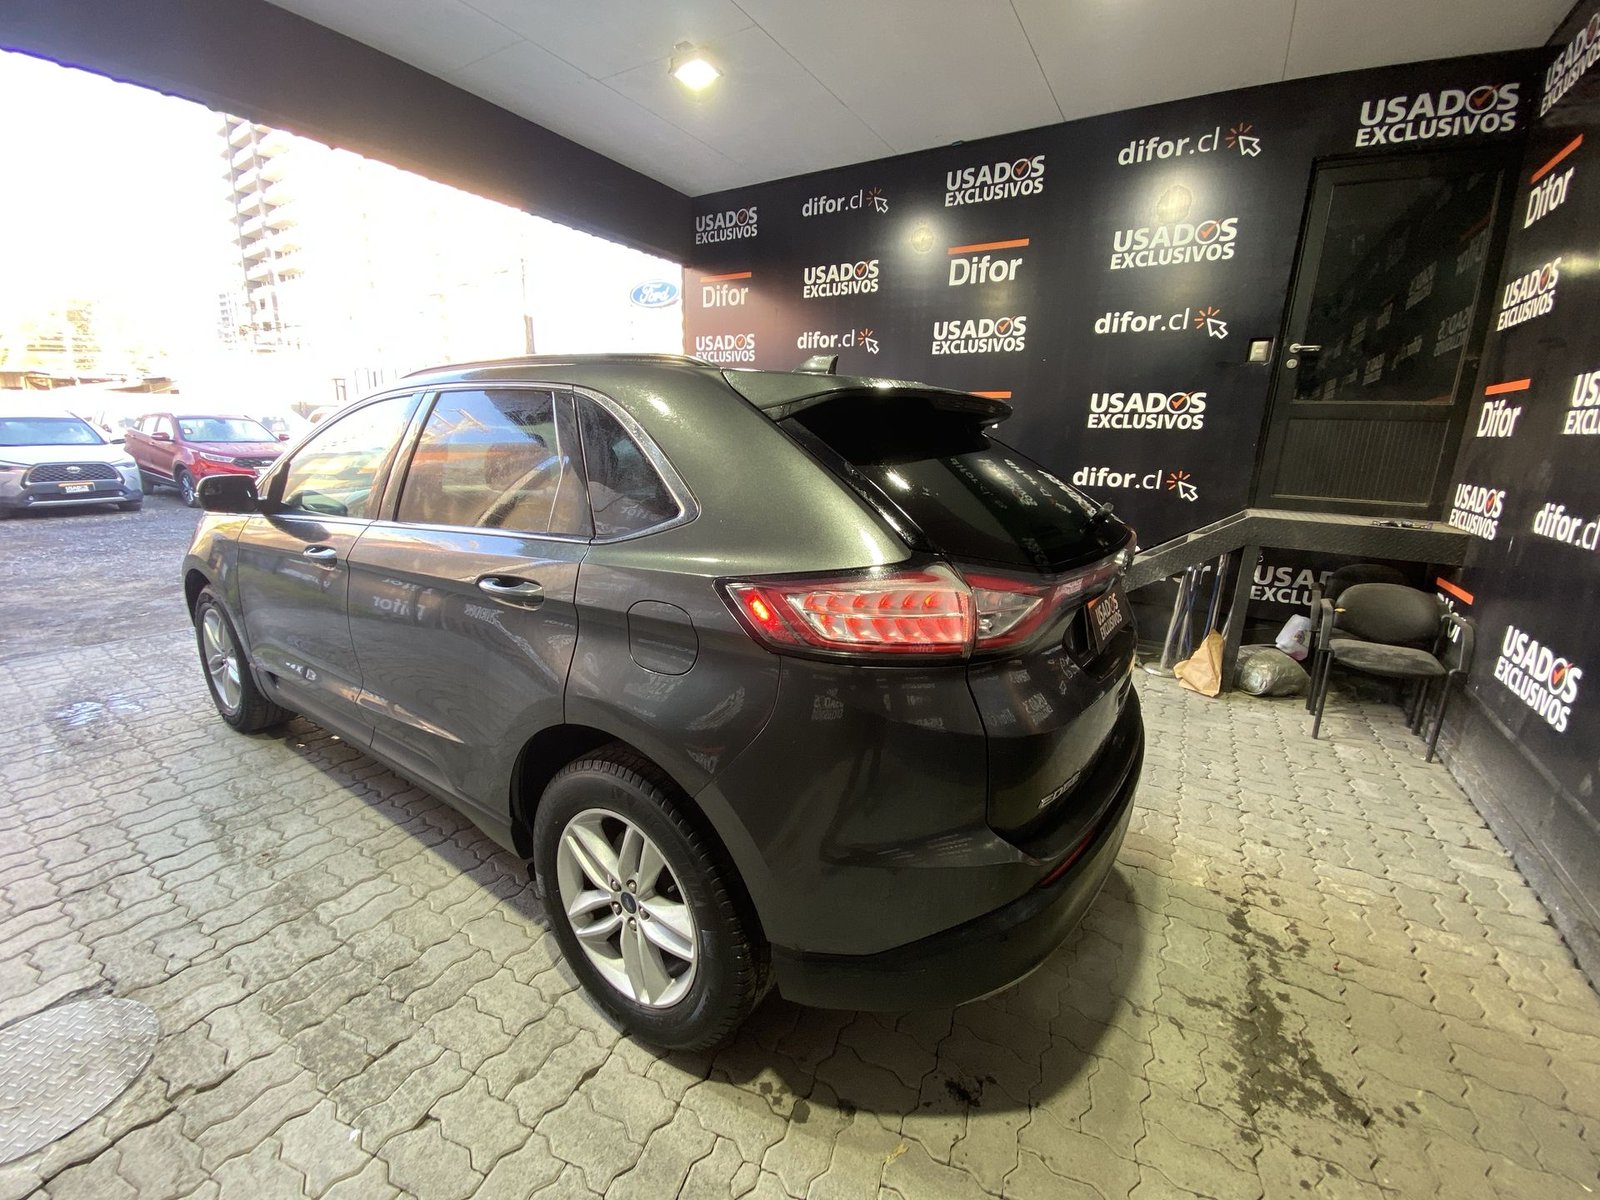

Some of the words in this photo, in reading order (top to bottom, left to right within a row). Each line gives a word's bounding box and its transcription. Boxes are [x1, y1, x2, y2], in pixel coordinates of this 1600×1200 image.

[1544, 12, 1600, 94] USADO
[1359, 83, 1520, 127] USADOS
[1354, 112, 1516, 148] EXCLUSIVOS
[1117, 126, 1221, 166] difor.cl
[946, 154, 1045, 191] USADOS
[801, 188, 863, 217] difor.cl
[944, 178, 1044, 208] EXCLUSIVOS
[1523, 166, 1575, 229] Difor
[695, 206, 758, 234] USADOS
[695, 226, 758, 245] EXCLUSIVOS
[1113, 217, 1239, 253] USADOS
[948, 254, 1023, 287] Difor
[1110, 241, 1235, 270] EXCLUSIVOS
[803, 259, 880, 285] USADOS
[1502, 256, 1562, 310] USADOS
[702, 284, 749, 309] Difor
[803, 278, 879, 299] EXCLUSIVOS
[1094, 307, 1191, 334] difor.cl
[1496, 289, 1556, 332] EXCLUSIVOS
[695, 333, 756, 352] USADOS
[796, 328, 855, 350] difor.cl
[933, 315, 1027, 341] USADOS
[931, 336, 1026, 355] EXCLUSIVOS
[1089, 391, 1207, 416] USADOS
[1476, 399, 1522, 438] Difor
[1087, 413, 1205, 430] EXCLUSIVOS
[1072, 466, 1163, 490] difor.cl
[1453, 483, 1506, 519] USADOS
[1448, 508, 1499, 541] EXCLUSIVOS
[1533, 502, 1600, 551] difor.cl
[1501, 624, 1583, 705] USADOS
[1493, 654, 1573, 733] EXCLUSIVOS
